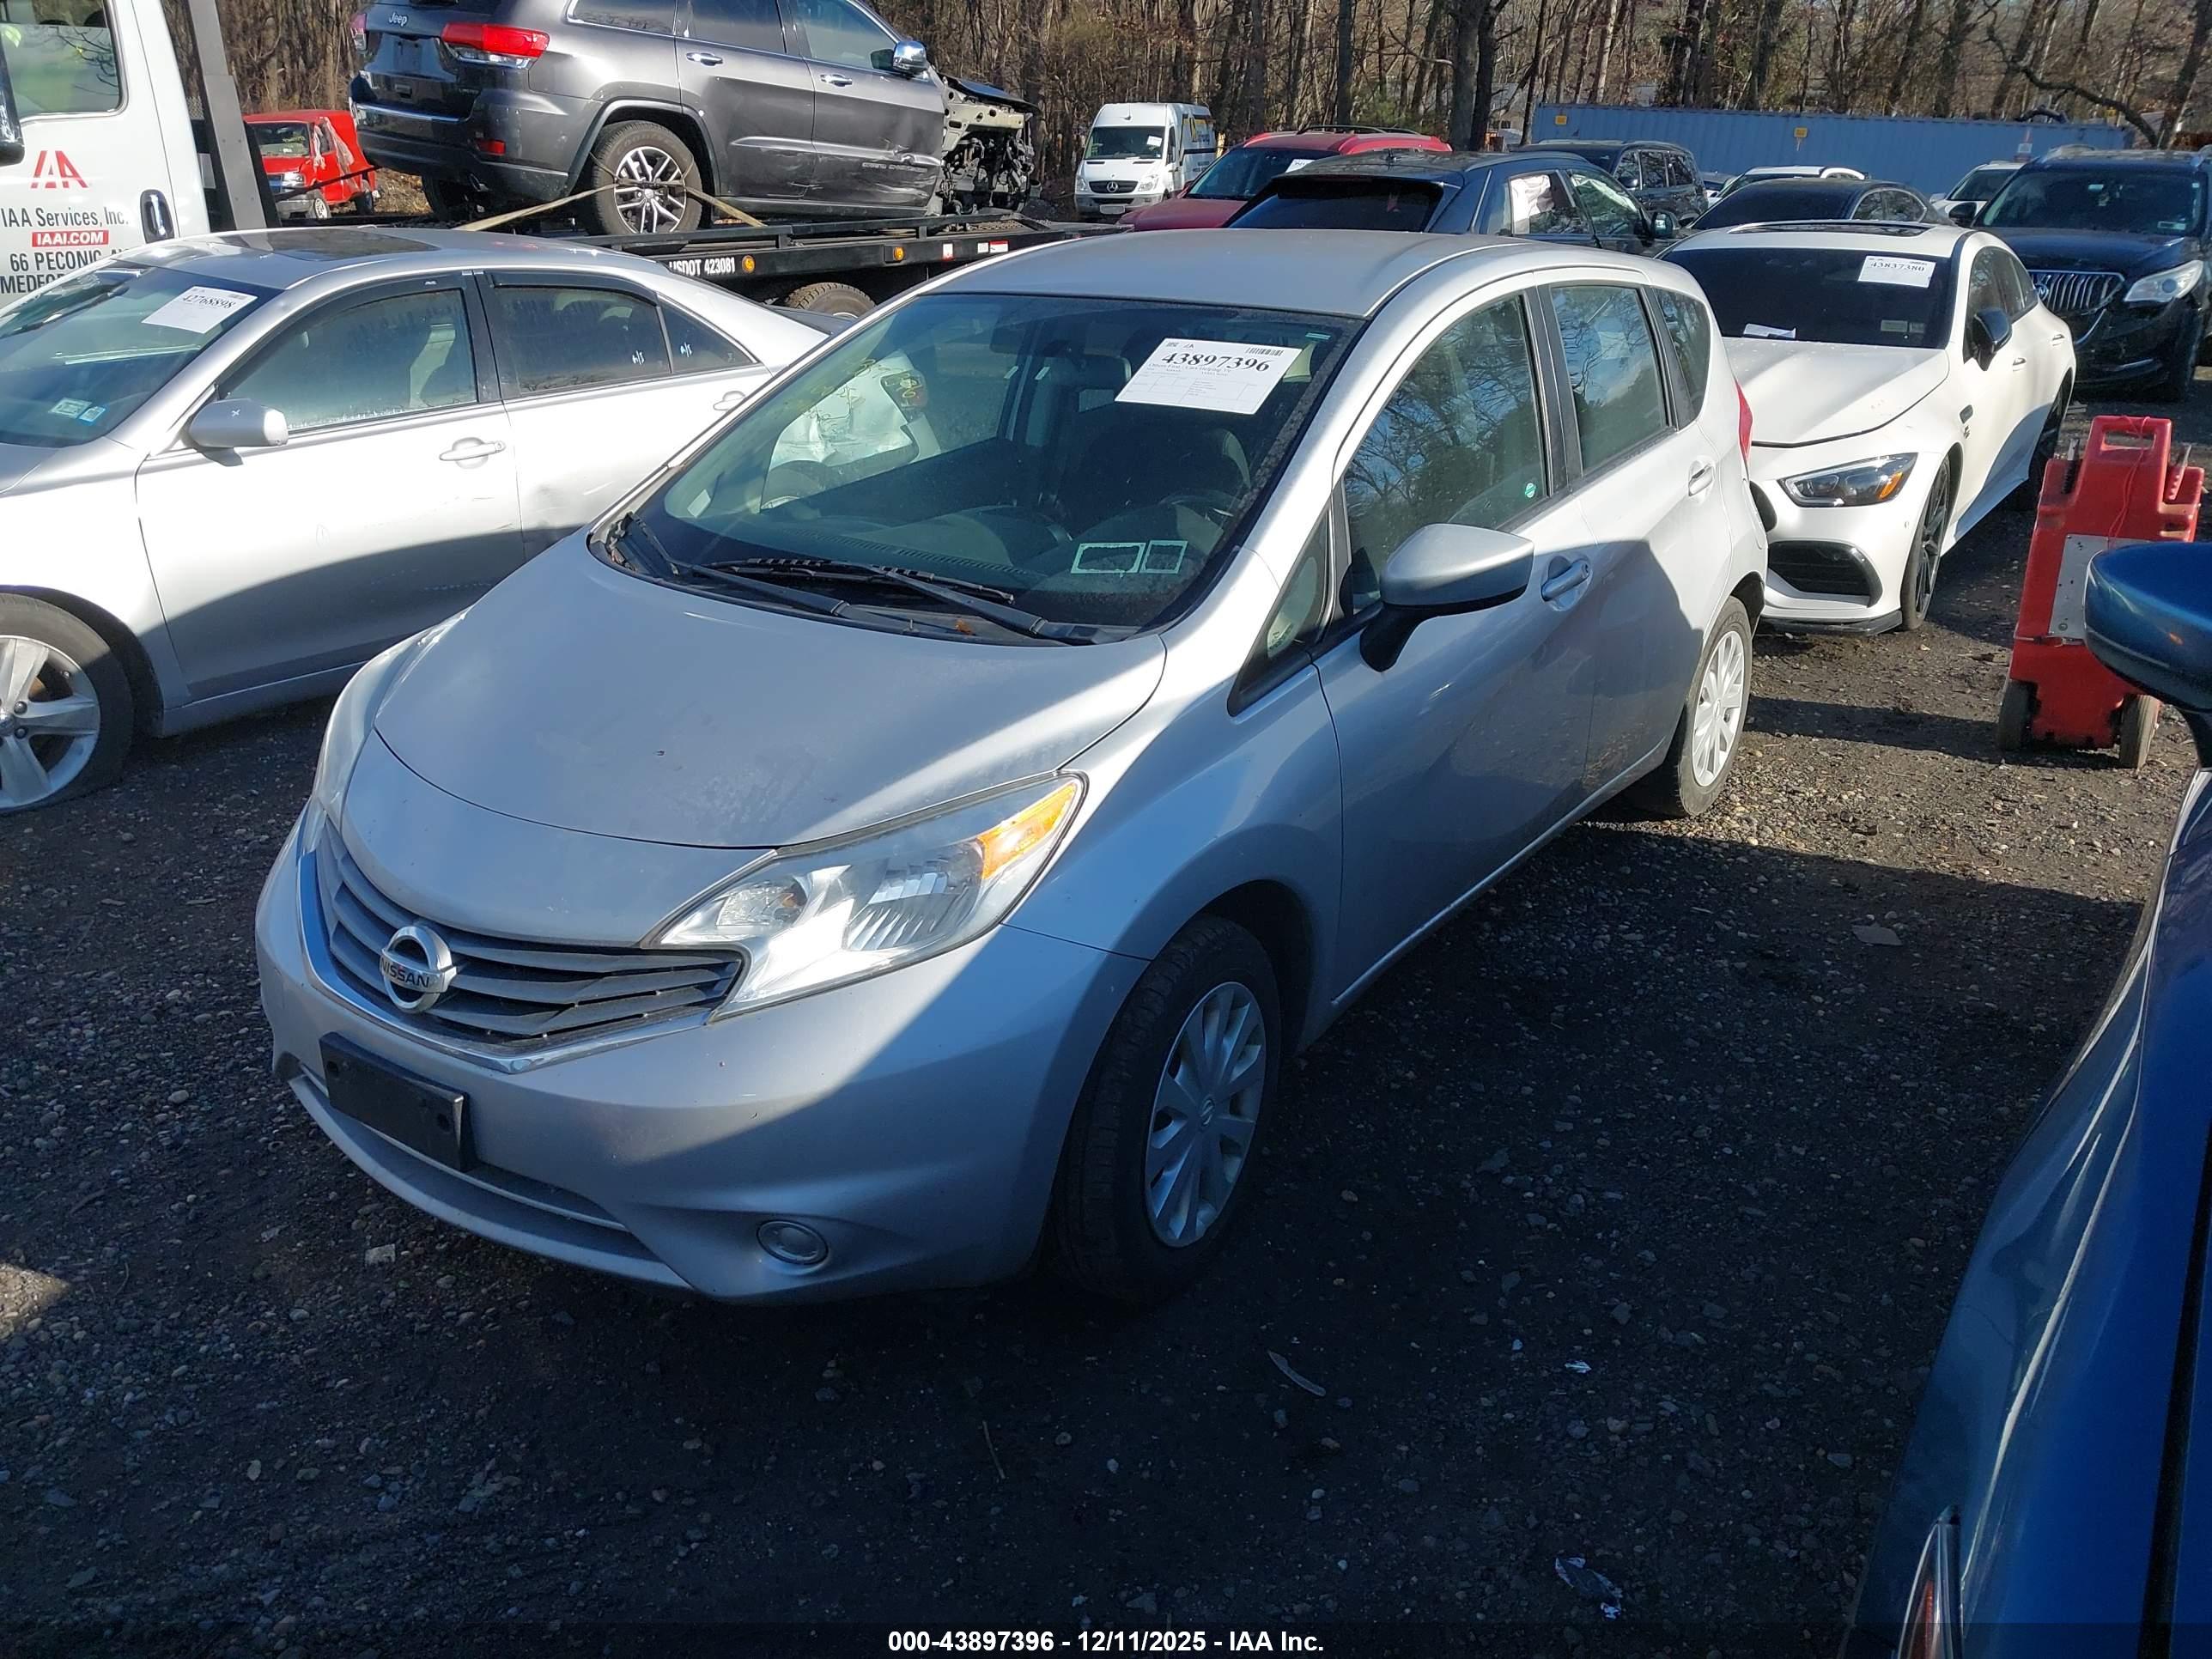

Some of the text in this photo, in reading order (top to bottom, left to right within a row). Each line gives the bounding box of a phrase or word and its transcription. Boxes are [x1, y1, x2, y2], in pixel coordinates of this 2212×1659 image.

[389, 12, 409, 27] Jeep
[1, 206, 129, 228] IAA Services, Inc.
[36, 231, 104, 246] IAAI.COM
[9, 253, 29, 271] 66
[704, 257, 736, 274] 423081
[1161, 351, 1273, 373] 43897396
[380, 957, 430, 988] NISSAN
